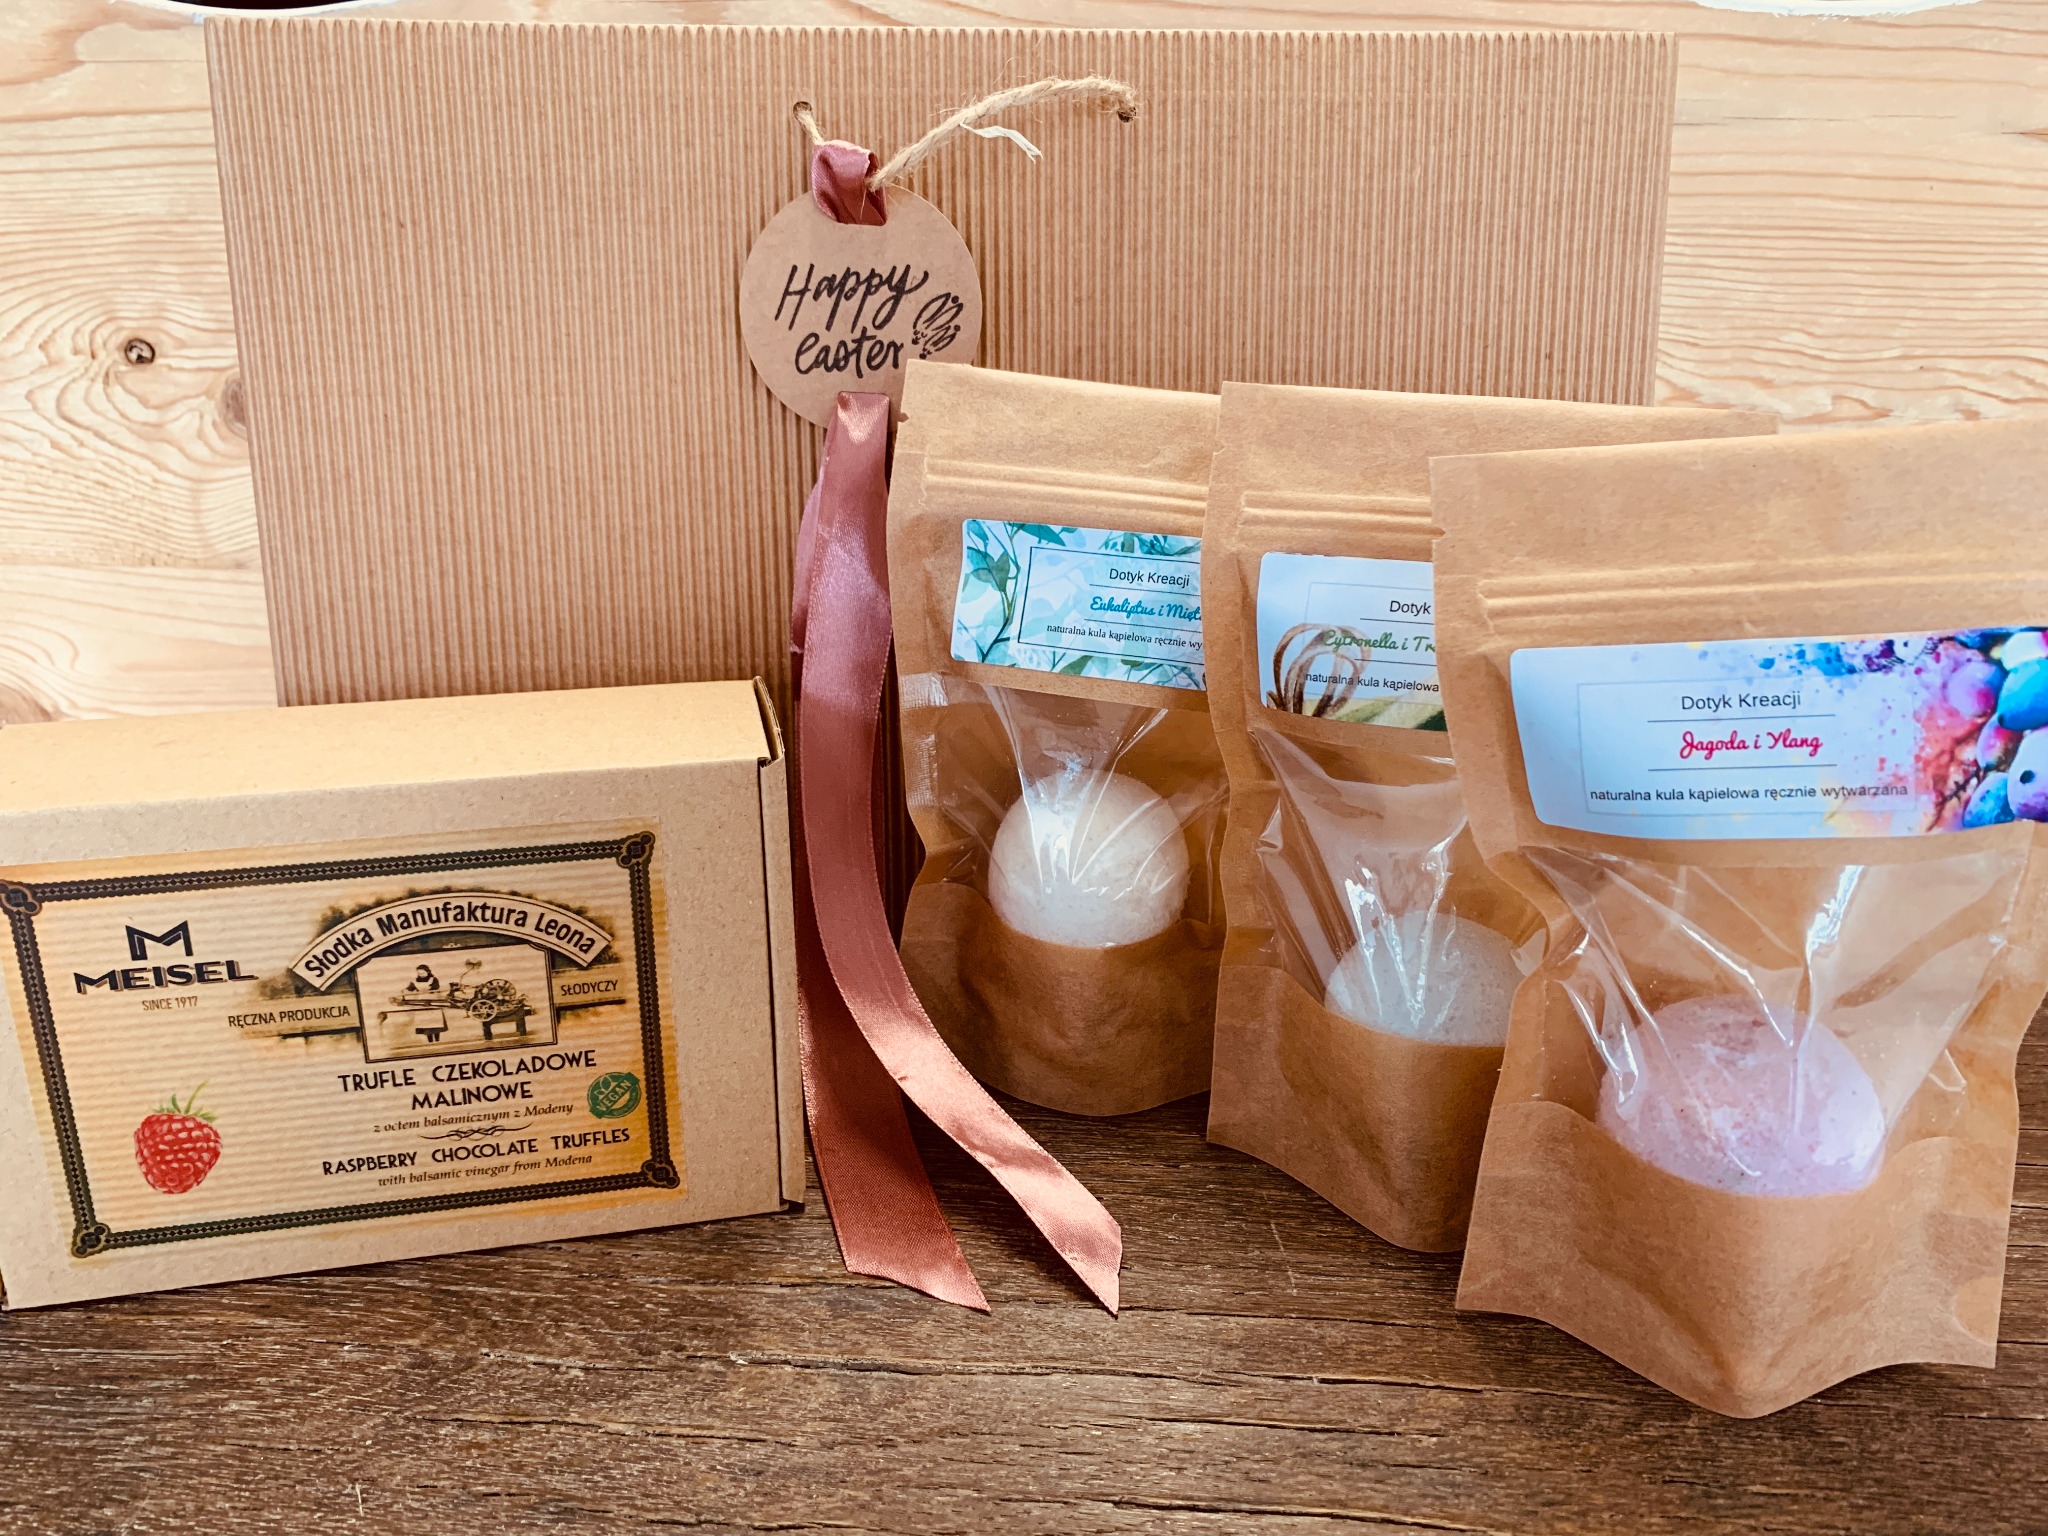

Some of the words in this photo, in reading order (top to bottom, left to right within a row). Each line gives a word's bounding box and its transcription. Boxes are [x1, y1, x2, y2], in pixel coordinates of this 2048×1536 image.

[774, 263, 930, 333] Happy
[1108, 568, 1144, 585] Dotyk
[1147, 572, 1190, 588] Kreacji
[1090, 596, 1156, 619] Eukaliptus
[1157, 605, 1164, 616] i
[1166, 603, 1202, 621] Mięt
[1389, 600, 1432, 617] Dotyk
[1046, 624, 1086, 636] naturalna
[1088, 629, 1107, 639] kula
[1108, 630, 1152, 644] kąpielowa
[1154, 636, 1187, 647] ręcznie
[1189, 641, 1203, 651] wy
[1323, 629, 1399, 653] Cytronella
[1401, 638, 1408, 651] i
[1413, 636, 1436, 652] Tr
[1305, 672, 1354, 686] naturalna
[1357, 676, 1380, 688] kula
[1383, 680, 1439, 692] kąpielowa
[1681, 694, 1733, 712] Dotyk
[1738, 691, 1801, 709] Kreacji
[1679, 730, 1750, 760] Jagoda
[1753, 734, 1762, 749] i
[1766, 728, 1823, 757] Ylang
[1590, 788, 1651, 801] naturalna
[1656, 787, 1684, 801] kula
[1688, 786, 1760, 802] kąpielowa
[1764, 785, 1816, 800] ręcznie
[1820, 783, 1908, 799] wytwarzana
[304, 926, 374, 978] Słodka
[376, 901, 527, 938] Manufaktura
[534, 911, 597, 953] Leona
[73, 959, 259, 995] MEISEL
[561, 979, 618, 997] SŁODYCZY
[142, 998, 173, 1012] SINCE
[175, 995, 199, 1009] 1917
[227, 1012, 277, 1029] RĘCZNA
[279, 1005, 351, 1024] PRODUKCJA
[337, 1068, 417, 1093] TRUFLE
[431, 1049, 597, 1083] CZEKOLADOWE
[411, 1080, 533, 1111] MALINOWE
[596, 1079, 632, 1112] VEGAN
[374, 1125, 381, 1133] z
[384, 1120, 420, 1133] octem
[424, 1110, 510, 1129] balsamicznym
[514, 1109, 521, 1119] z
[524, 1102, 574, 1118] Modeny
[322, 1151, 418, 1176] RASPBERRY
[431, 1138, 539, 1164] CHOCOLATE
[551, 1127, 631, 1151] TRUFFLES
[378, 1173, 406, 1188] with
[409, 1167, 461, 1184] balsamic
[465, 1163, 511, 1182] vinegar
[511, 1160, 541, 1176] from
[544, 1153, 593, 1170] Modena
